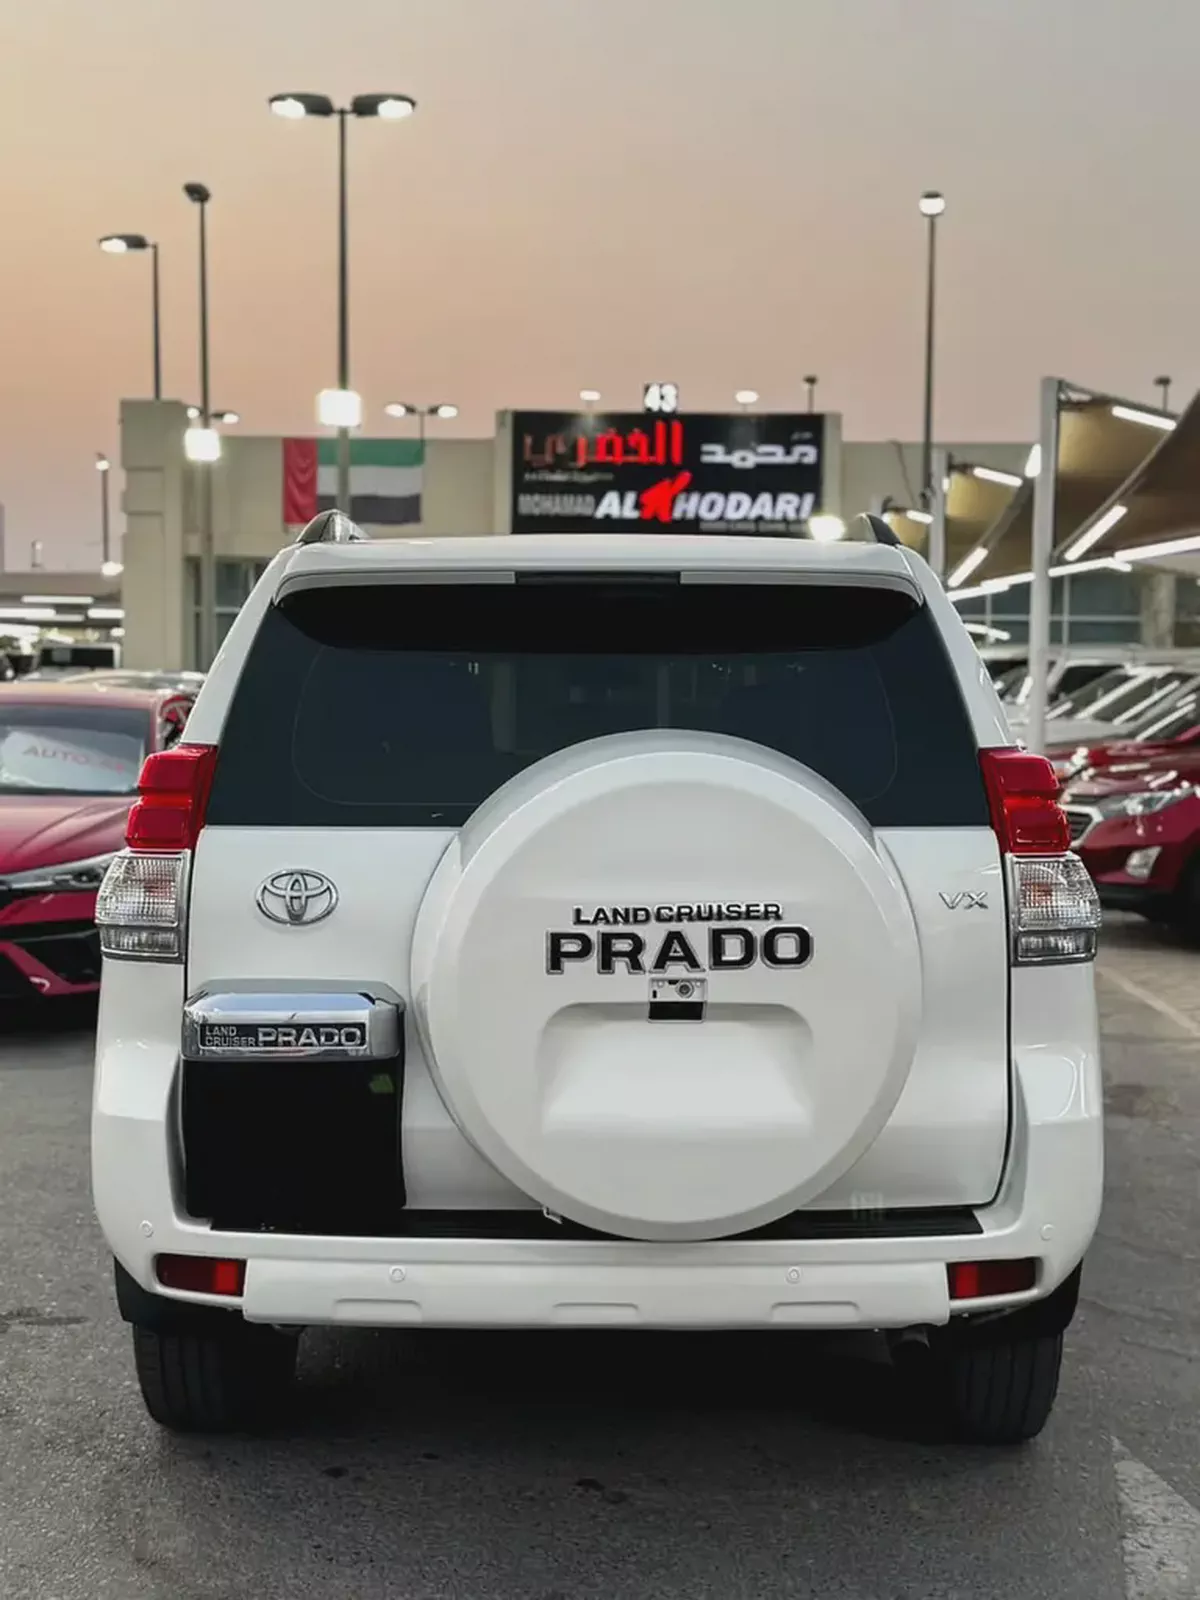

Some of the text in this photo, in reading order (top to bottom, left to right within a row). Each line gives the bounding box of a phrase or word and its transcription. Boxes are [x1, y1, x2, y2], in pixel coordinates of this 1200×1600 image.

[644, 382, 679, 413] 43
[700, 443, 818, 470] محمد
[938, 891, 989, 910] VX
[573, 902, 784, 925] LAND CRUISER
[545, 924, 815, 975] PRADO
[205, 1025, 238, 1037] LAND
[205, 1036, 256, 1047] CRUISER
[257, 1027, 362, 1047] PRADO
